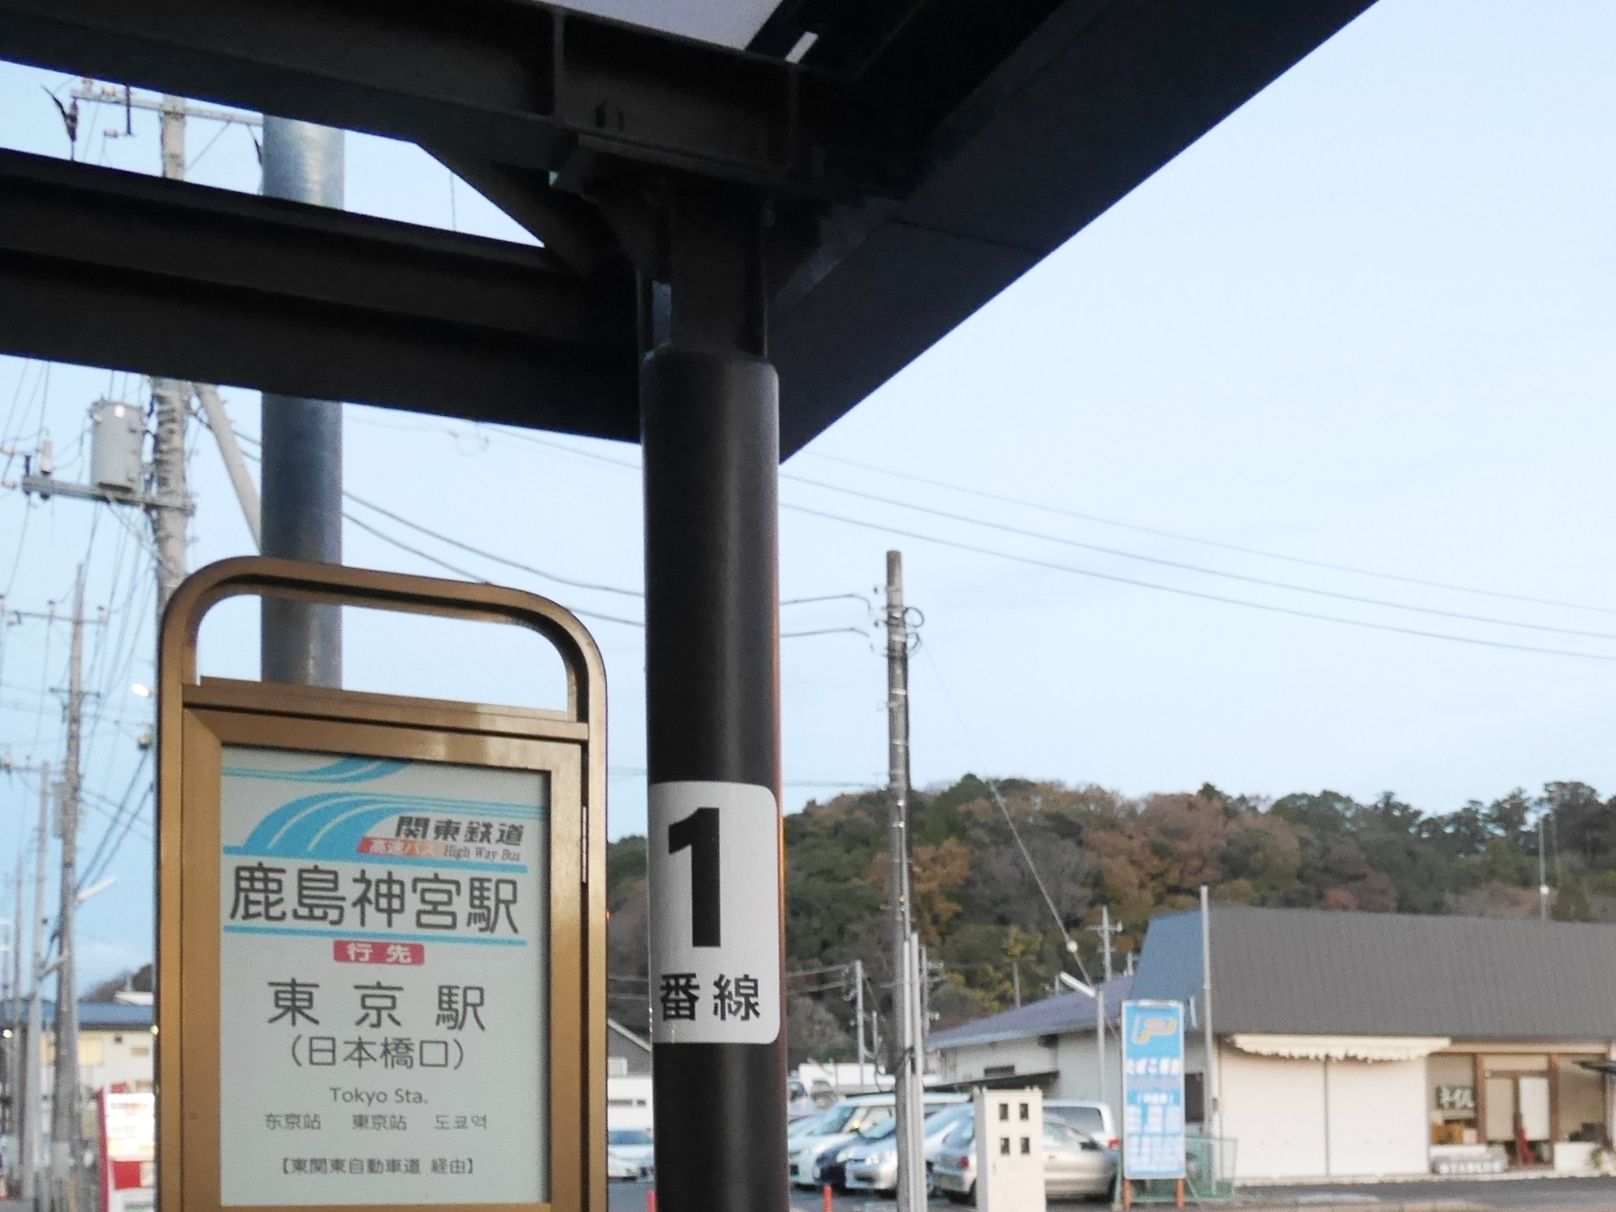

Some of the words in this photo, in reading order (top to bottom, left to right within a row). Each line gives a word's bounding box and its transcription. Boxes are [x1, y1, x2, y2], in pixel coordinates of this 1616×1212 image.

[395, 816, 525, 846] 関東鉄道
[444, 844, 471, 860] High
[475, 847, 498, 862] Way
[502, 849, 521, 862] Bus
[668, 807, 721, 948] 1
[229, 861, 520, 935] 鹿島神宮駅
[347, 942, 412, 964] 行先
[267, 977, 486, 1032] 東京駅
[659, 972, 761, 1022] 番線
[291, 1034, 464, 1071] (日本橋口)
[329, 1086, 388, 1108] Tokyo
[394, 1088, 428, 1104] Sta.
